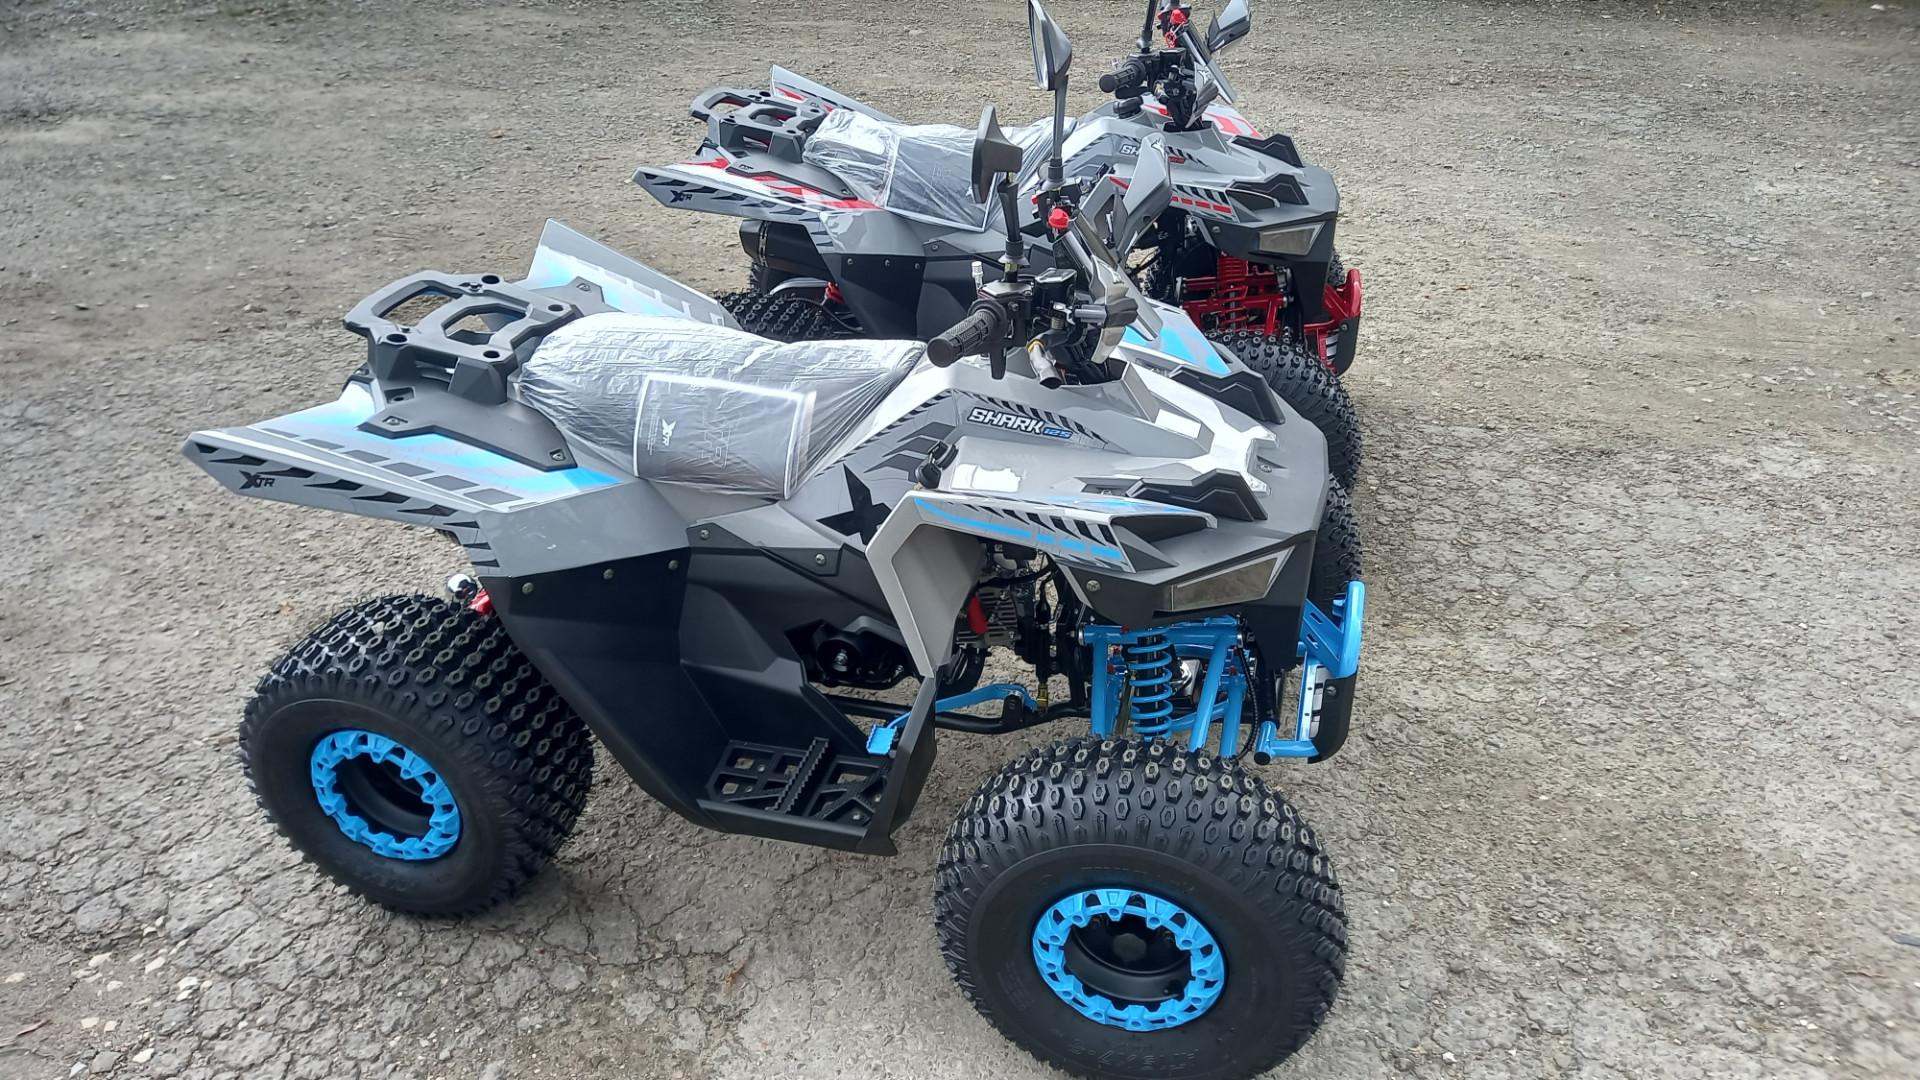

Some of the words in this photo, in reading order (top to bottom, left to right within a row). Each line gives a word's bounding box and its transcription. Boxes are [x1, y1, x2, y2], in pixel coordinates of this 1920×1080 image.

[967, 406, 1044, 434] SHARK
[1042, 427, 1073, 439] 125
[238, 470, 276, 490] XTR
